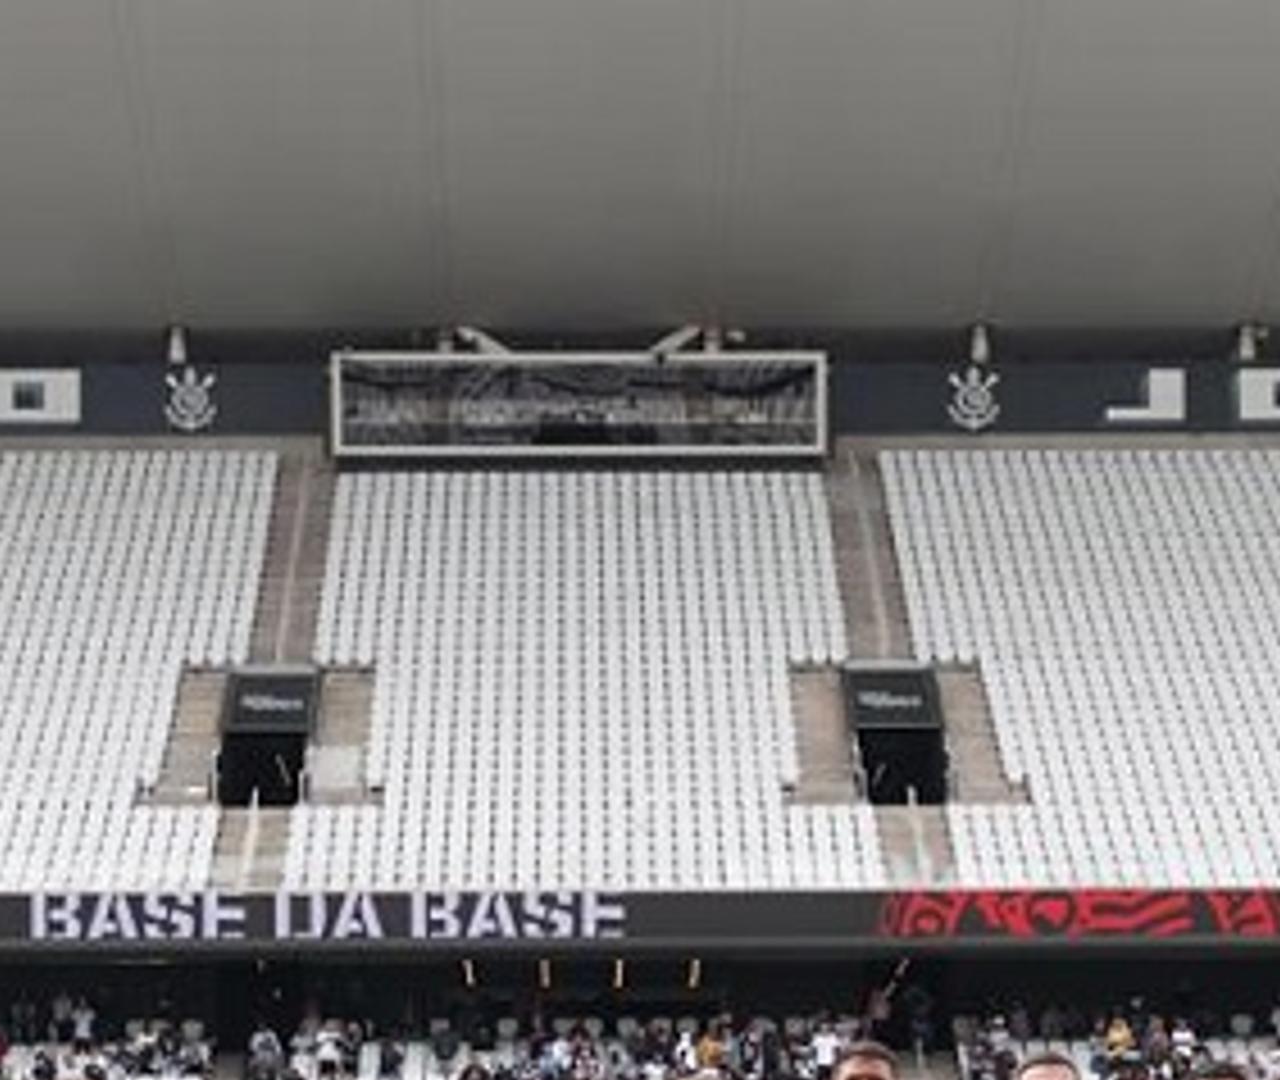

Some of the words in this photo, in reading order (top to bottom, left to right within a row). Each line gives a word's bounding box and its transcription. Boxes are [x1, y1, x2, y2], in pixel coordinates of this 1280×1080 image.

[30, 891, 246, 939] BASE
[274, 891, 383, 939] DA
[411, 891, 627, 939] BASE
